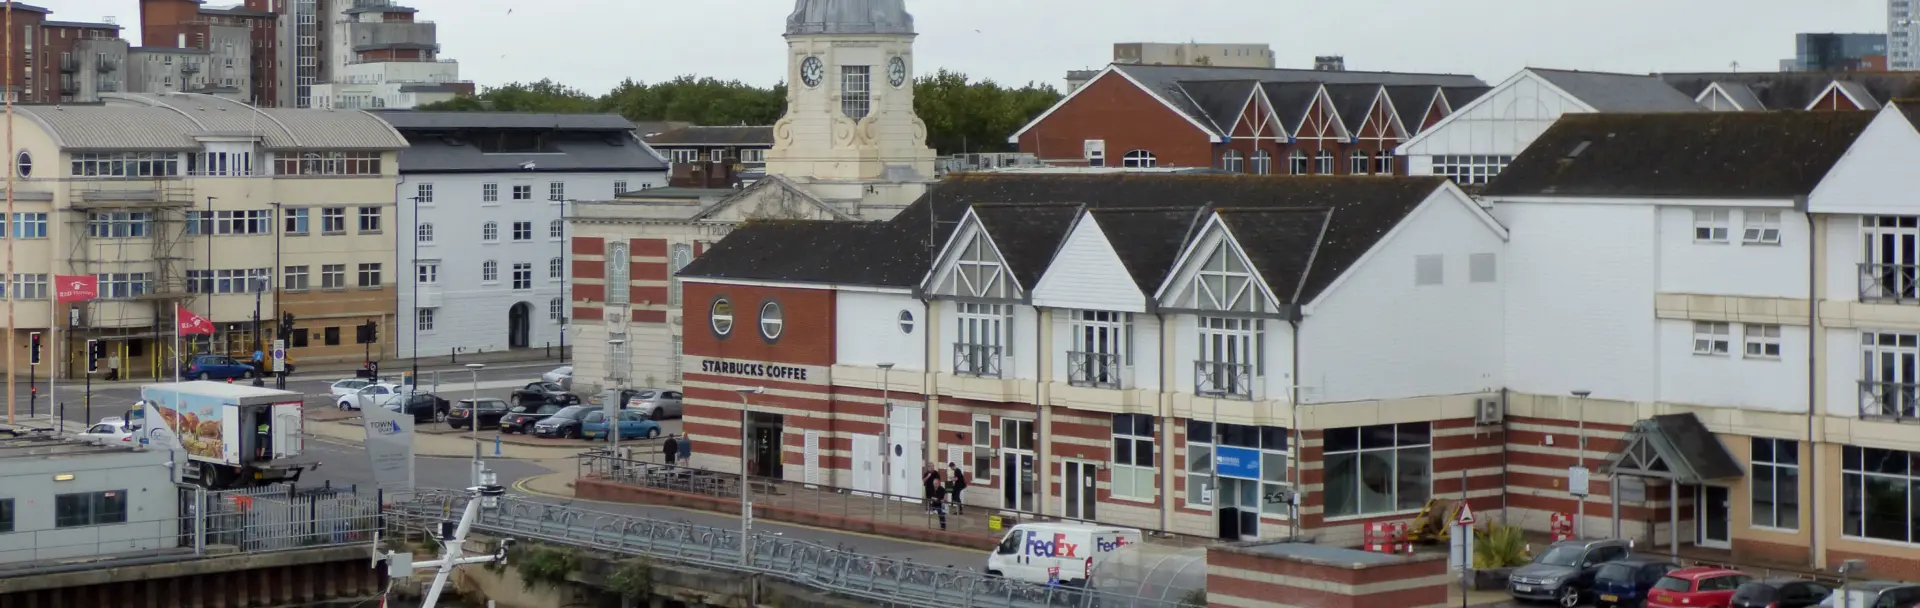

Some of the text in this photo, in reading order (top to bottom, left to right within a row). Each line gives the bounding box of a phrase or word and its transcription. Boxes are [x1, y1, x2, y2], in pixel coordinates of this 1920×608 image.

[702, 360, 807, 380] STARBUCKS COFFEE
[1025, 531, 1078, 558] FedEx
[1097, 536, 1134, 552] FedE
